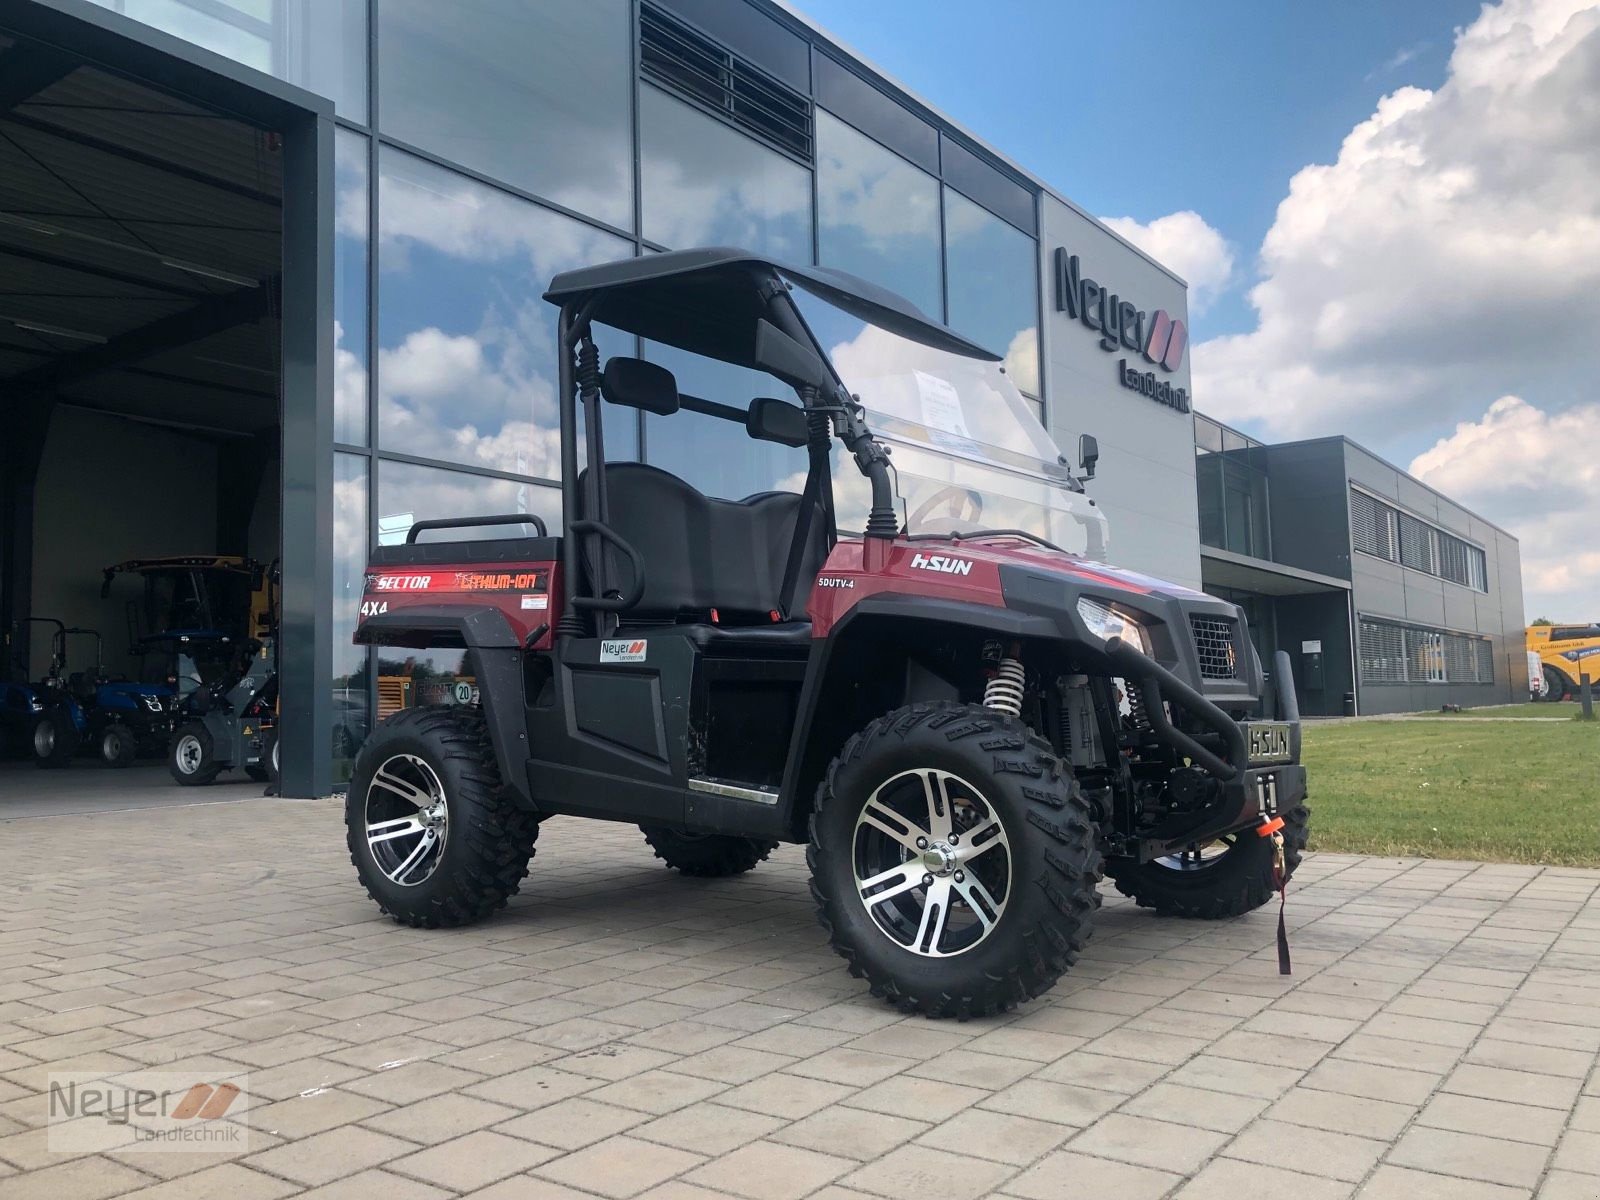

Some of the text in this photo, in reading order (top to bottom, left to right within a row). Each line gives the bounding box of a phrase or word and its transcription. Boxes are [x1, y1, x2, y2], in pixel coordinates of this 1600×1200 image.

[1055, 247, 1146, 352] Neyer
[910, 553, 973, 576] HSUN
[377, 575, 432, 590] SECTOR
[361, 601, 388, 616] 4X4
[602, 642, 630, 656] Neyer
[458, 686, 469, 700] 20
[1251, 729, 1289, 756] HSUN
